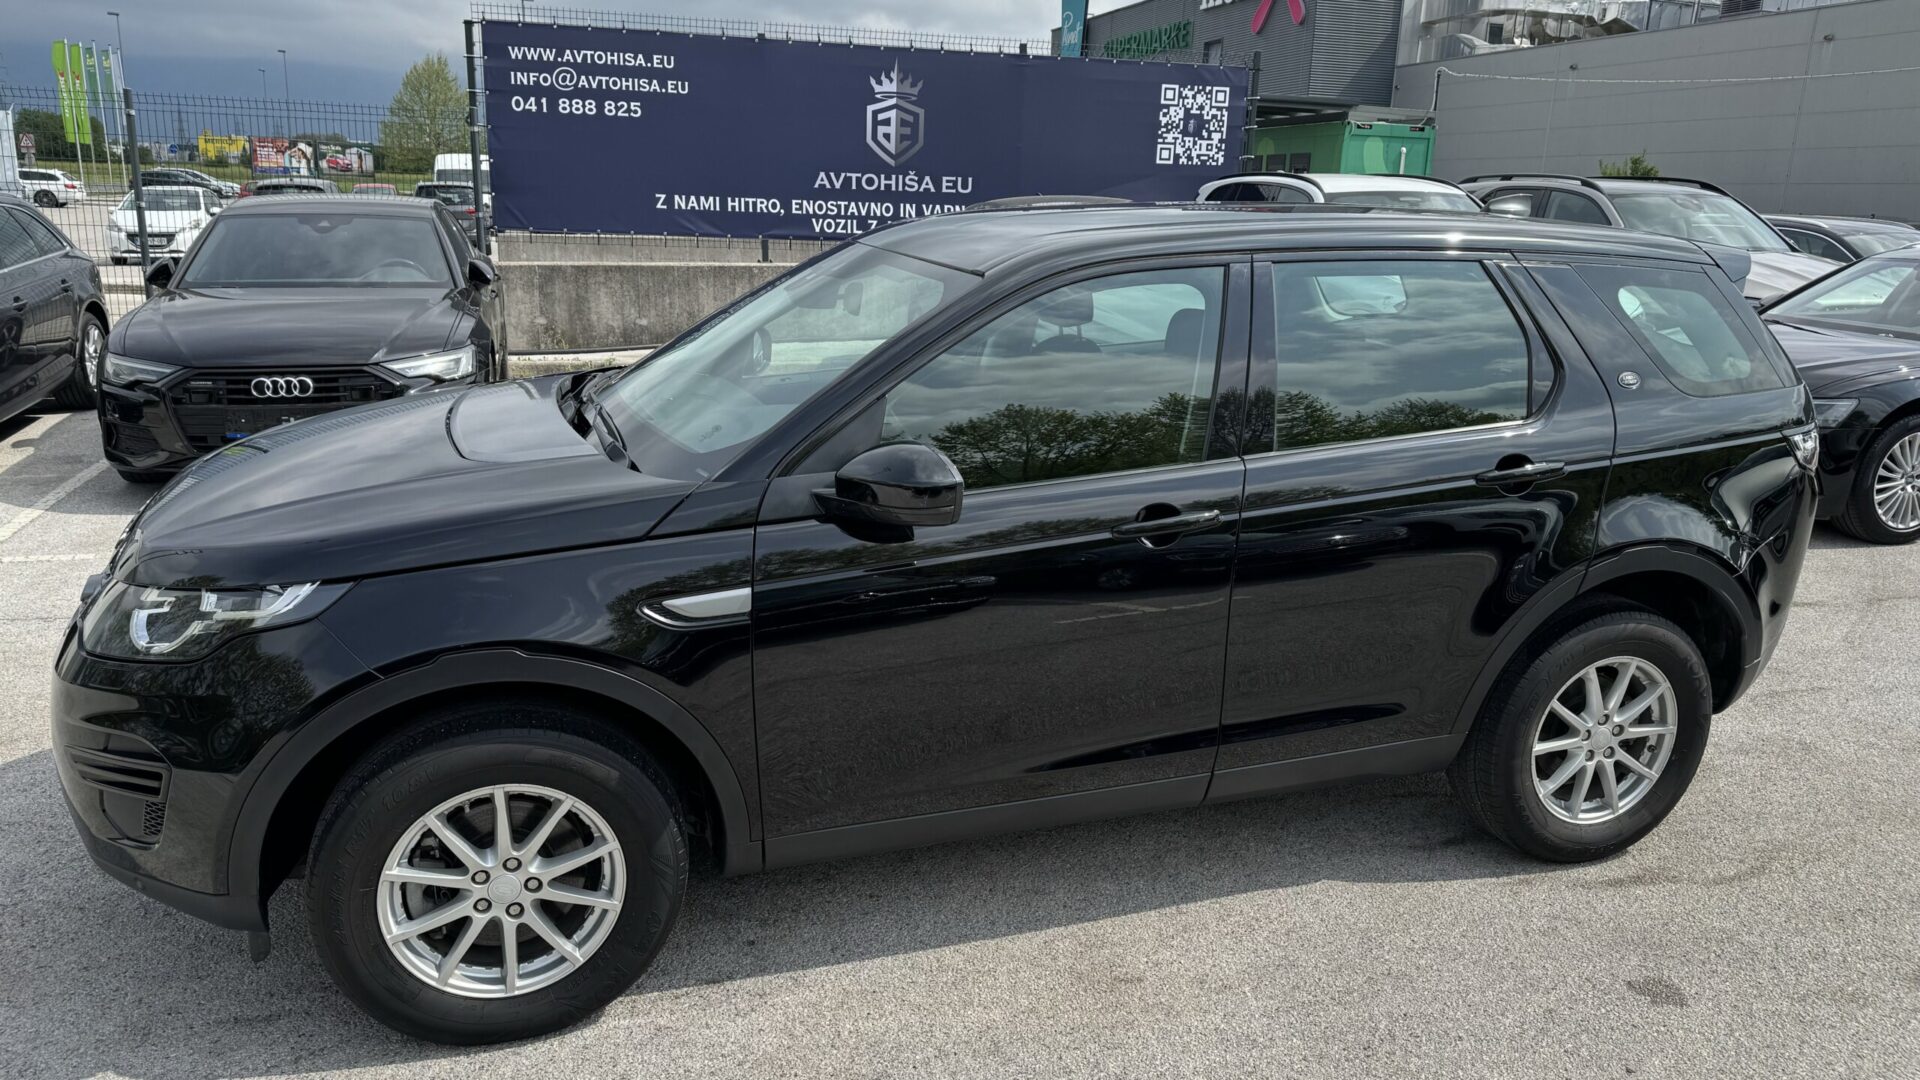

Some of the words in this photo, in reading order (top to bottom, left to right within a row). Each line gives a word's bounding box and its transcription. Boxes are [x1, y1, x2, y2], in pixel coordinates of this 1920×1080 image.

[508, 46, 675, 68] WWW.AVTOHISA.EU
[510, 66, 689, 94] INFO@AVTOHISA.EU
[511, 96, 548, 113] 041
[558, 98, 597, 115] 888
[604, 101, 642, 117] 825
[813, 171, 936, 193] AVTOHIŠA
[941, 177, 973, 194] EU
[655, 194, 667, 209] Z
[674, 195, 721, 212] NAMI
[727, 197, 785, 216] HITRO,
[791, 200, 894, 218] ENOSTAVNO
[900, 203, 916, 219] IN
[811, 218, 863, 234] VOZIL
